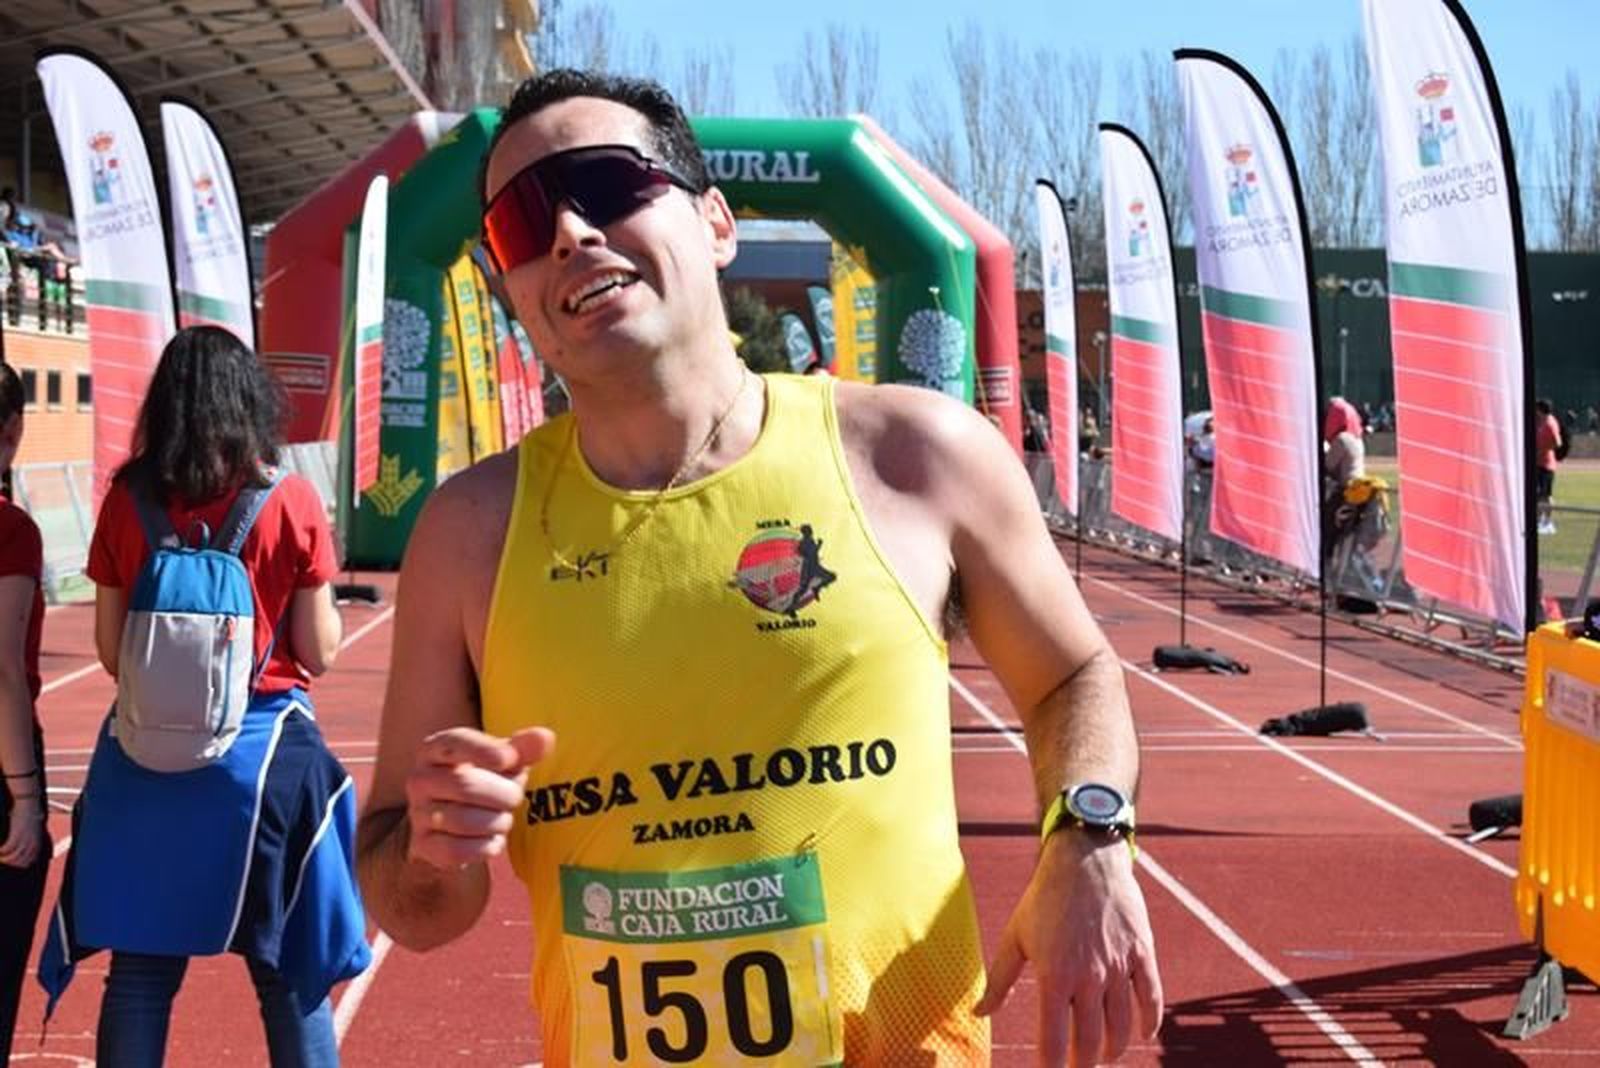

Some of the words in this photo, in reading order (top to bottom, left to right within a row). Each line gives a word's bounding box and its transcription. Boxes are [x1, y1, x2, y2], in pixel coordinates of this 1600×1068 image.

[702, 149, 820, 182] RURAL
[756, 519, 791, 530] MESA
[755, 617, 817, 633] VALORIO
[525, 772, 638, 826] MESA
[650, 739, 896, 801] VALORIO
[632, 812, 755, 845] ZAMORA
[617, 873, 785, 912] FUNDACION
[620, 911, 687, 938] CAJA
[691, 901, 788, 934] RURAL
[591, 950, 794, 1064] 150
